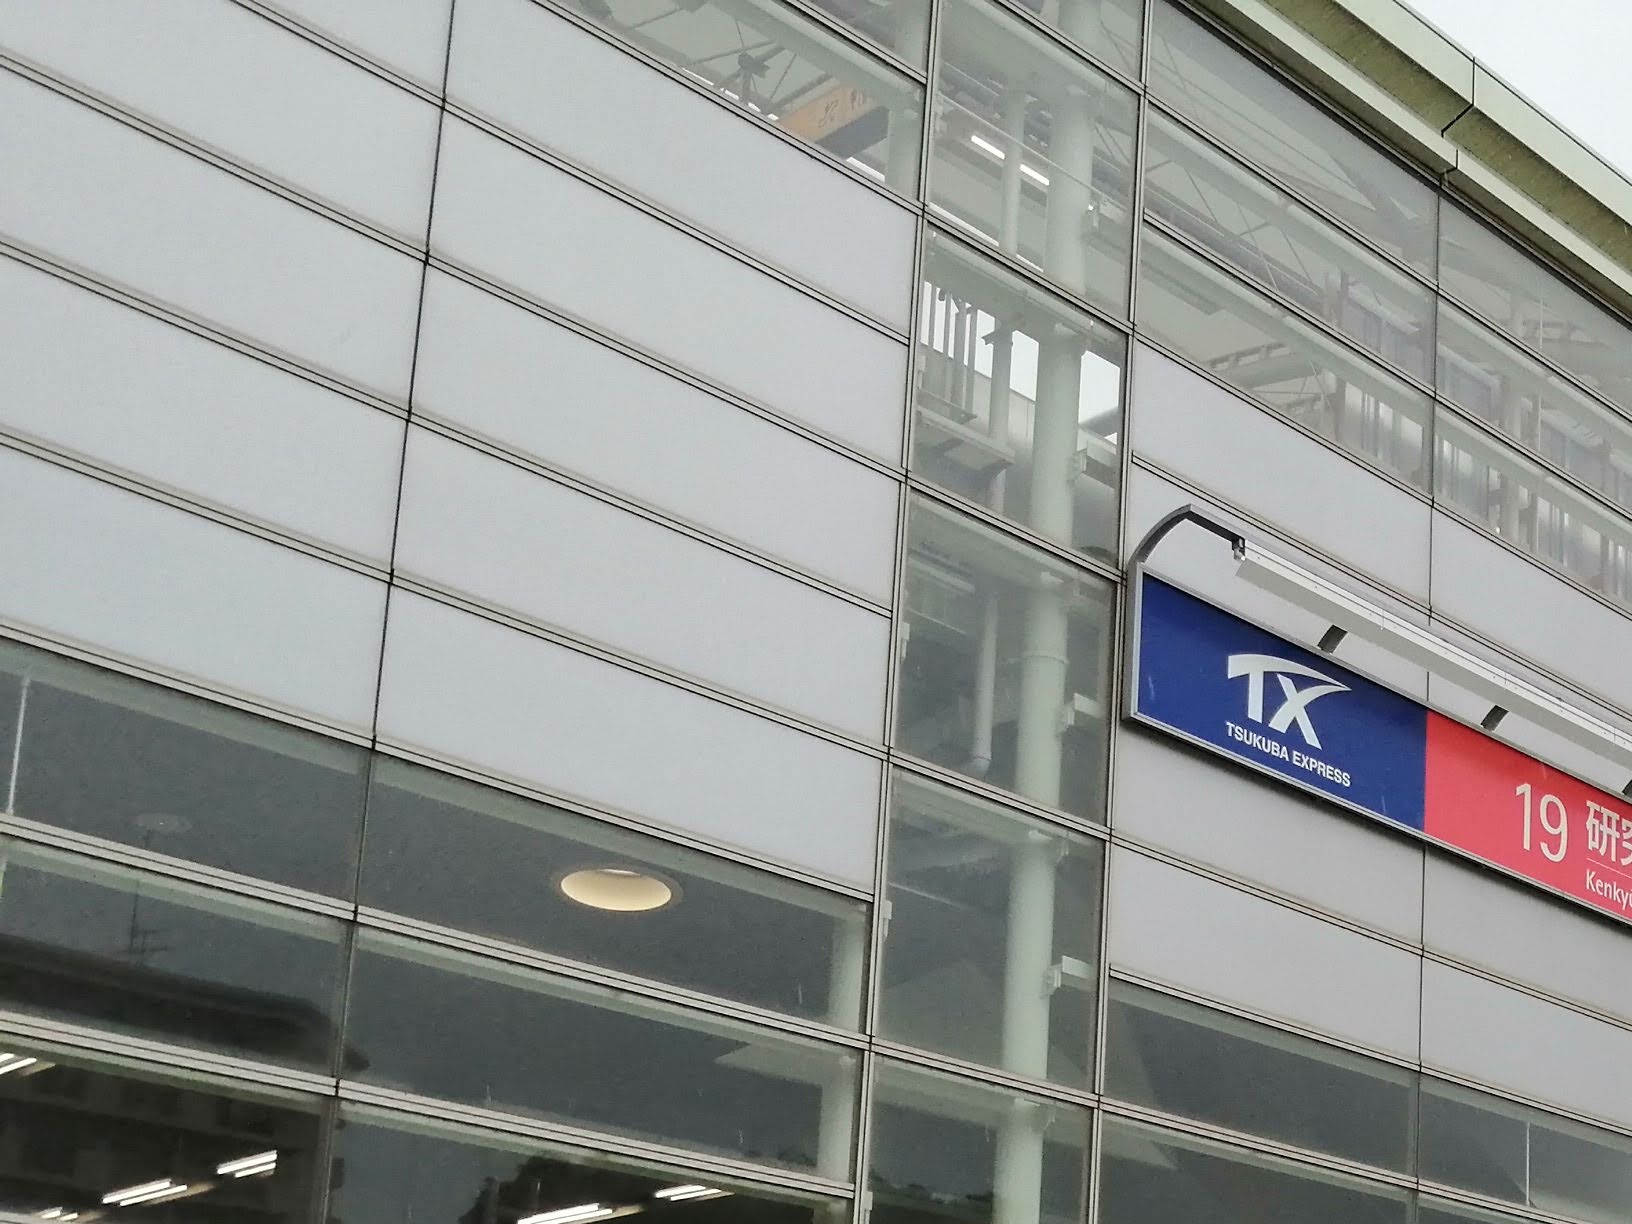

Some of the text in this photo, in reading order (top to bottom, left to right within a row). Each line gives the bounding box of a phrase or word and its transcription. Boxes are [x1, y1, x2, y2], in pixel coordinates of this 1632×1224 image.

[1228, 653, 1352, 750] TX
[1225, 721, 1351, 788] TSUKUBA EXPRESS
[1515, 783, 1569, 863] 19
